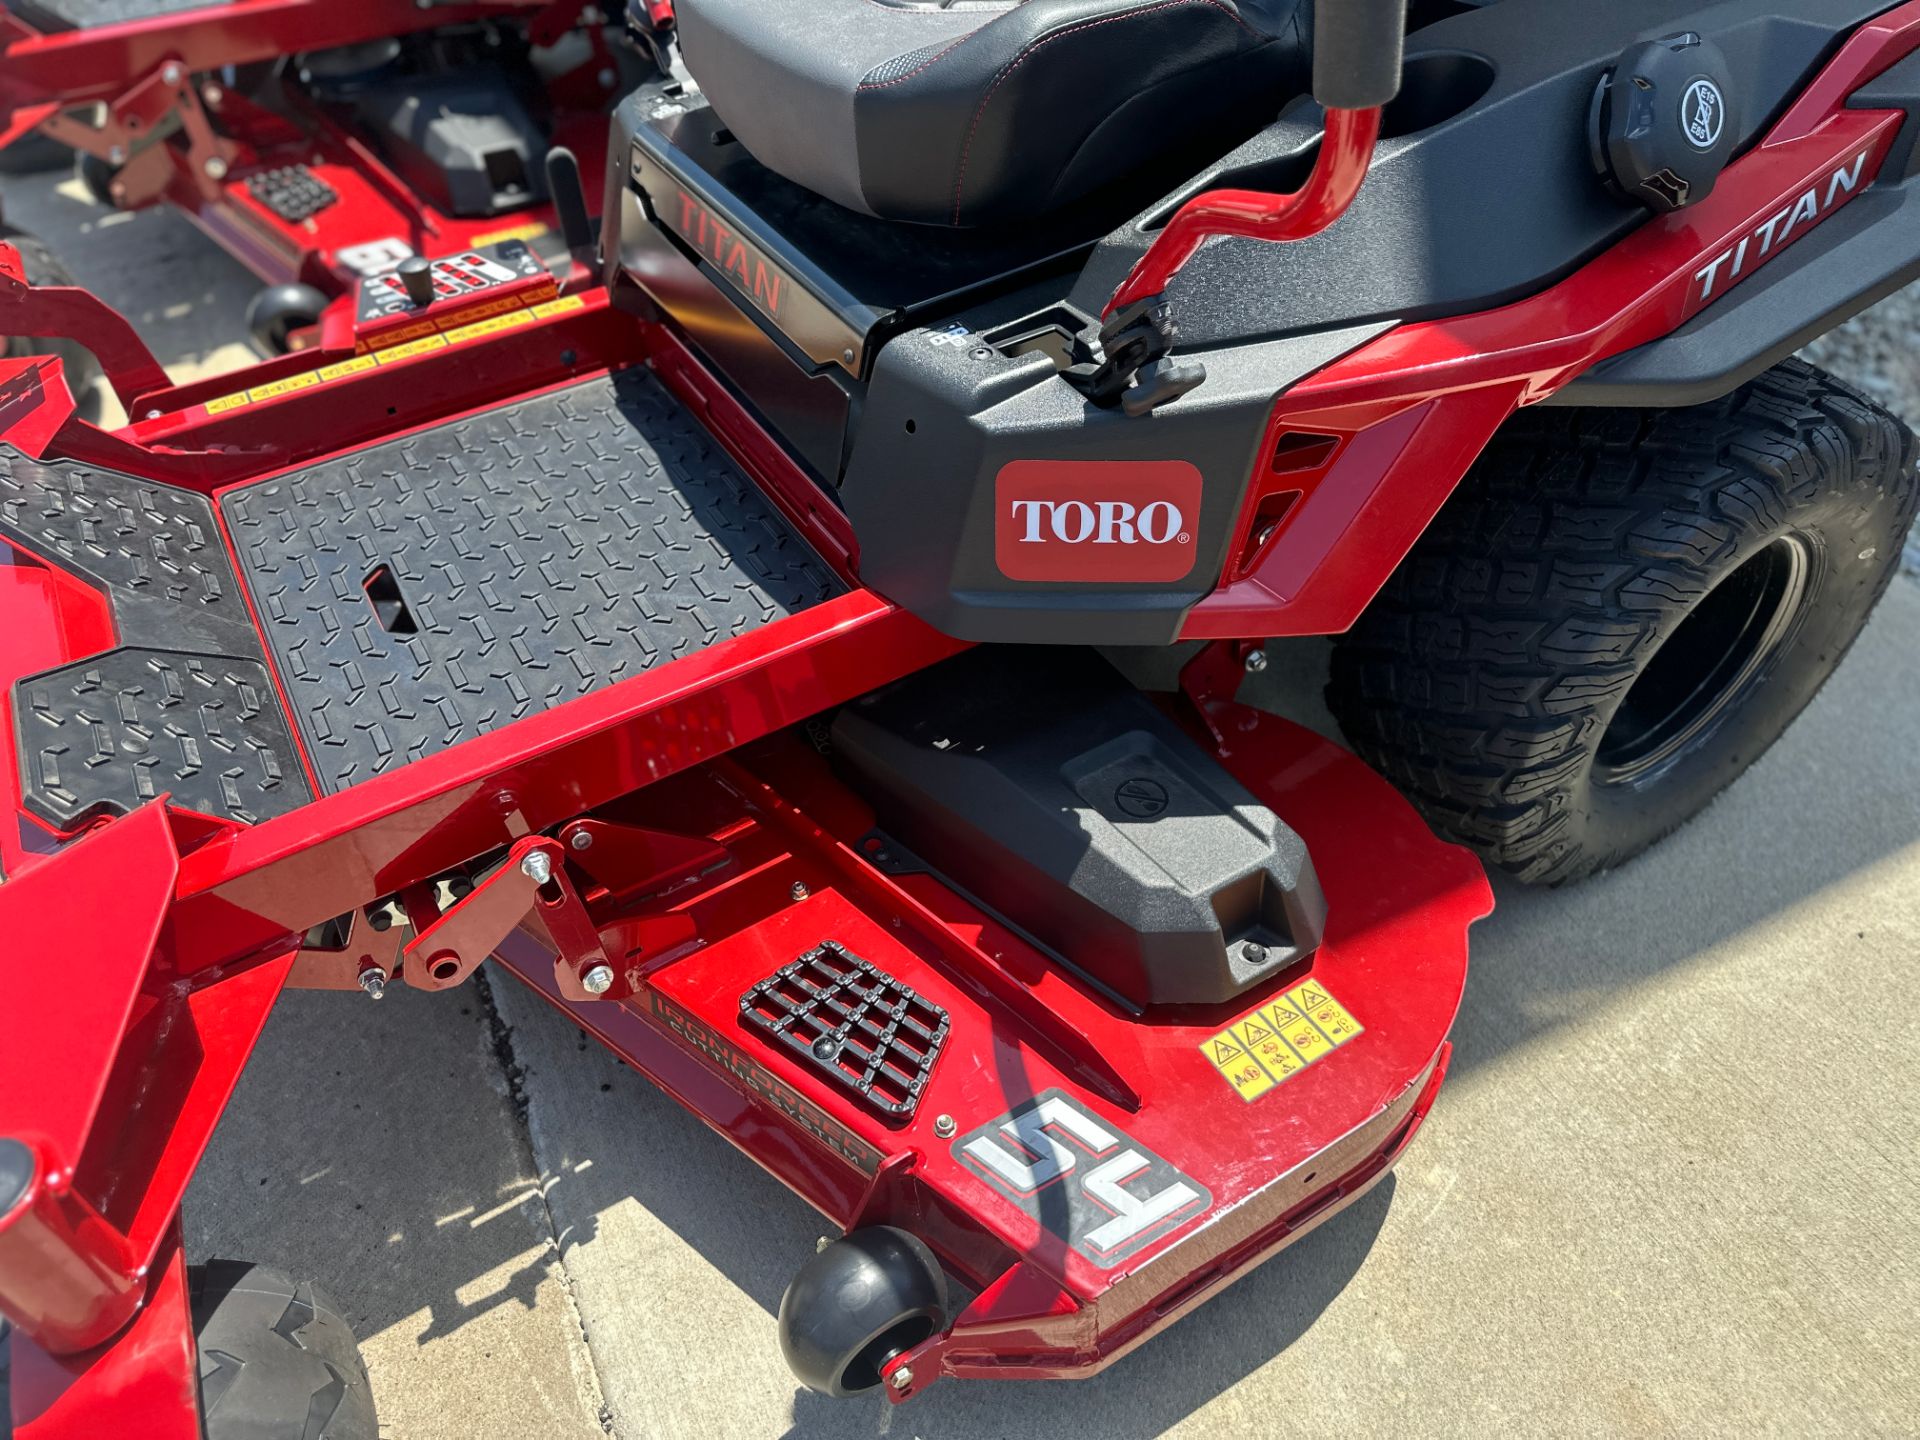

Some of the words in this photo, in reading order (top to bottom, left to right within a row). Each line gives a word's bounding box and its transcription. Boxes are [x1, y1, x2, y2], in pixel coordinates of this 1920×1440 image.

[1690, 122, 1705, 138] E85
[1701, 87, 1715, 104] E15
[677, 191, 781, 314] TITAN
[1695, 150, 1867, 301] TITAN
[656, 997, 868, 1161] IRONFORGED
[670, 1021, 759, 1091] CUTTING
[769, 1094, 859, 1165] SYSTEM
[962, 1097, 1201, 1257] 54
